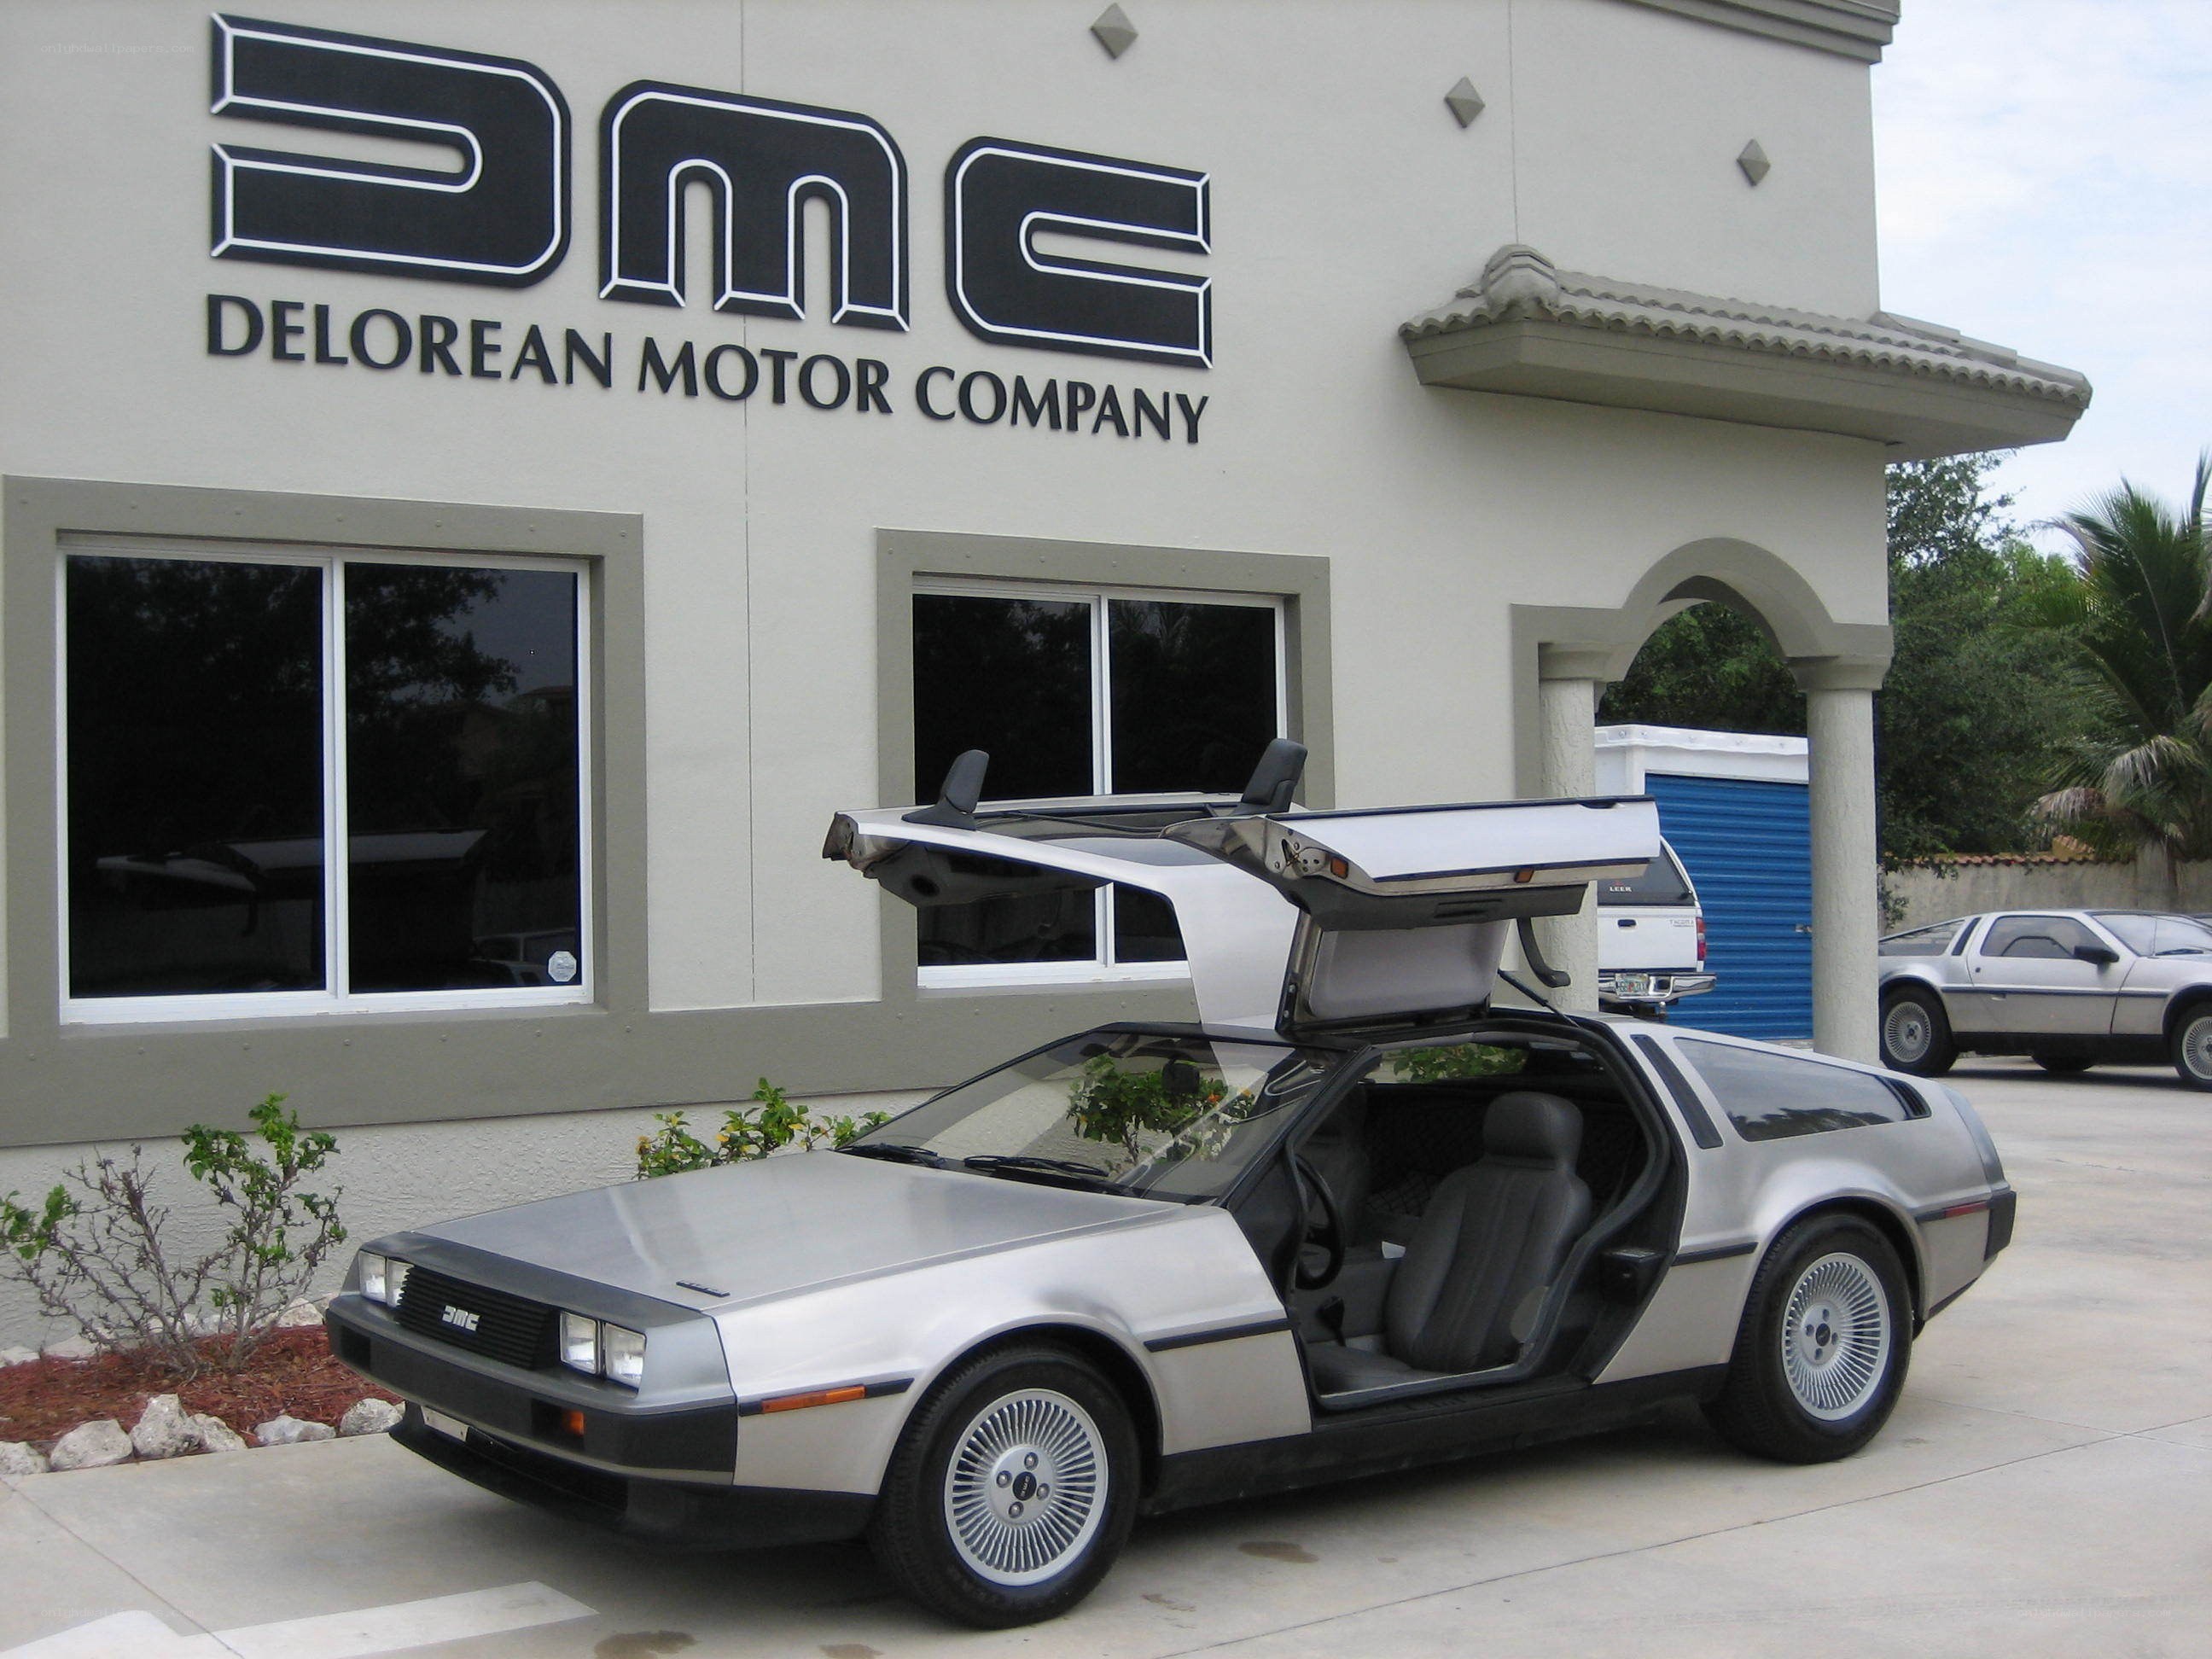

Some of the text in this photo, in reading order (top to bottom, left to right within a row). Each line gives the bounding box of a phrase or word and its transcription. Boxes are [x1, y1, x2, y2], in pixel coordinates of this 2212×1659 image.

[207, 294, 1209, 444] DELOREAN MOTOR COMPANY
